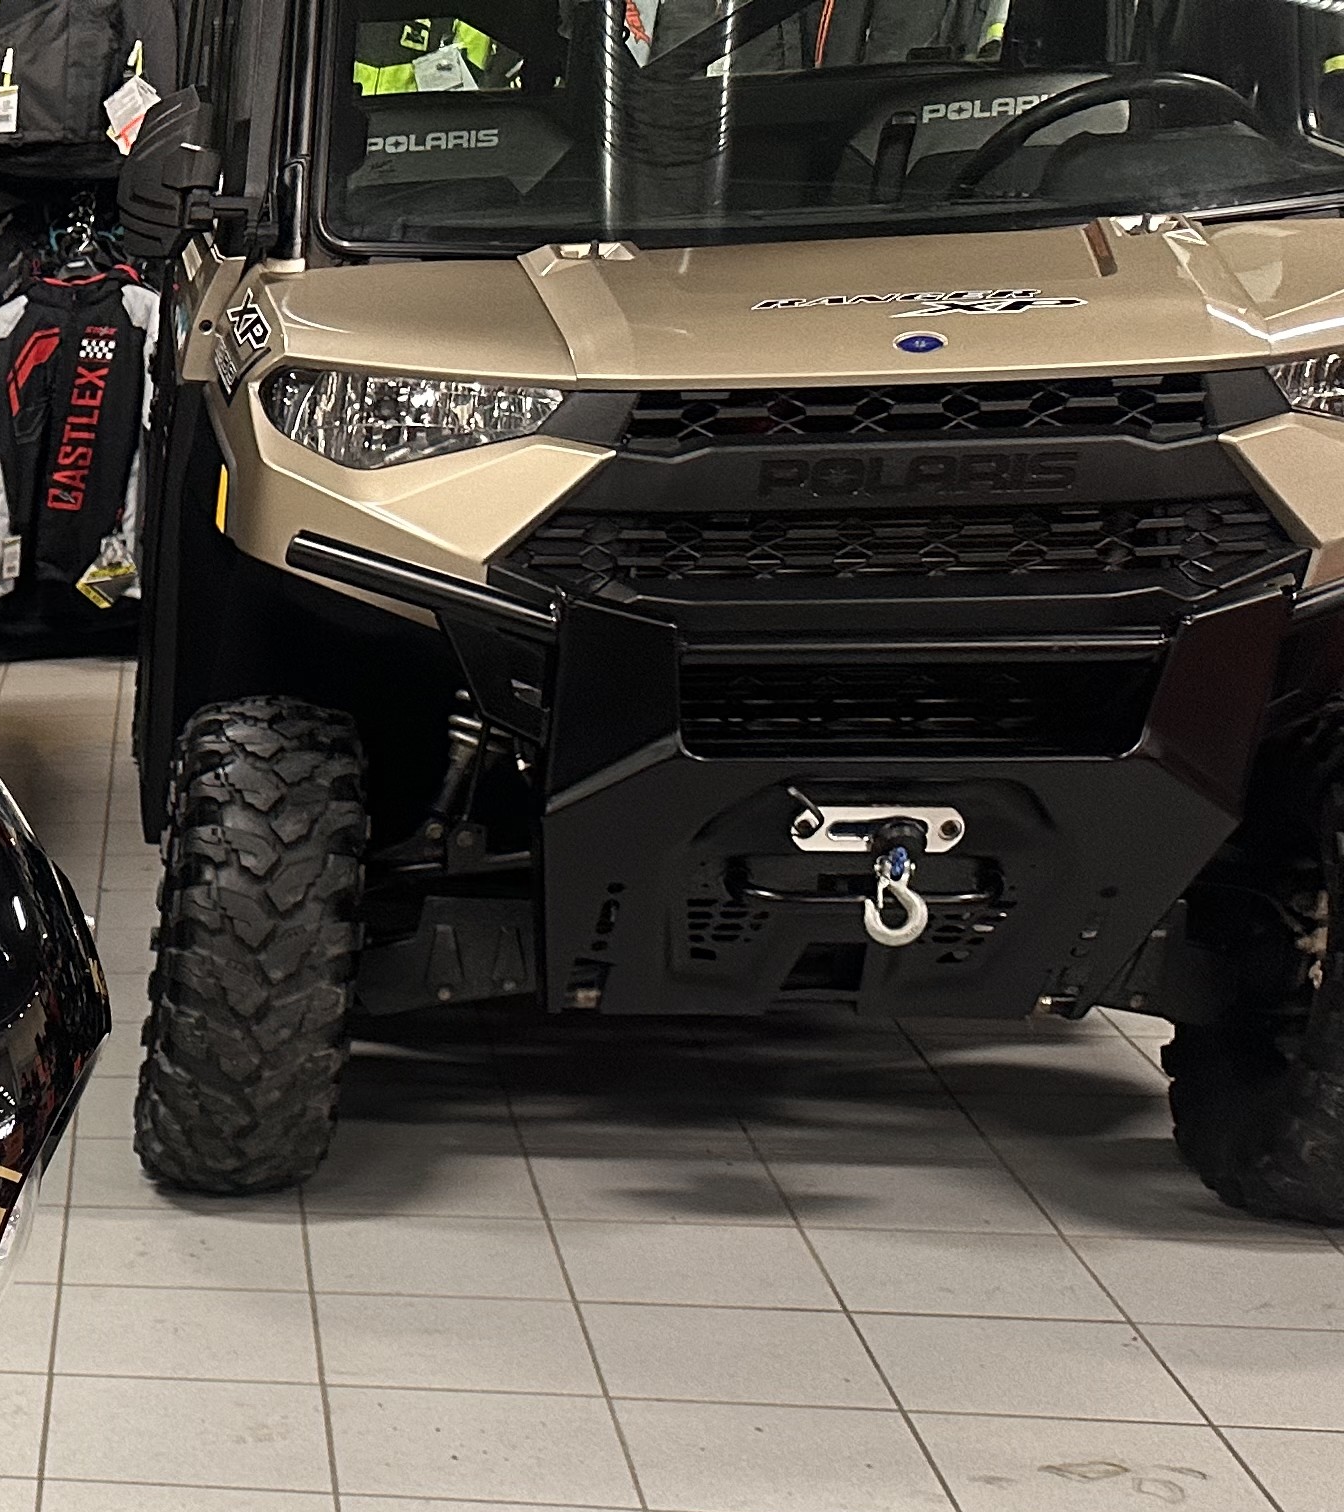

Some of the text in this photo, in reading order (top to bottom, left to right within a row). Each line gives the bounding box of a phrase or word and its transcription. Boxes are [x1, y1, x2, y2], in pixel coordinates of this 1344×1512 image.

[922, 93, 1057, 124] POLAR
[366, 128, 499, 154] POLARIS
[758, 451, 1079, 499] POLARIS
